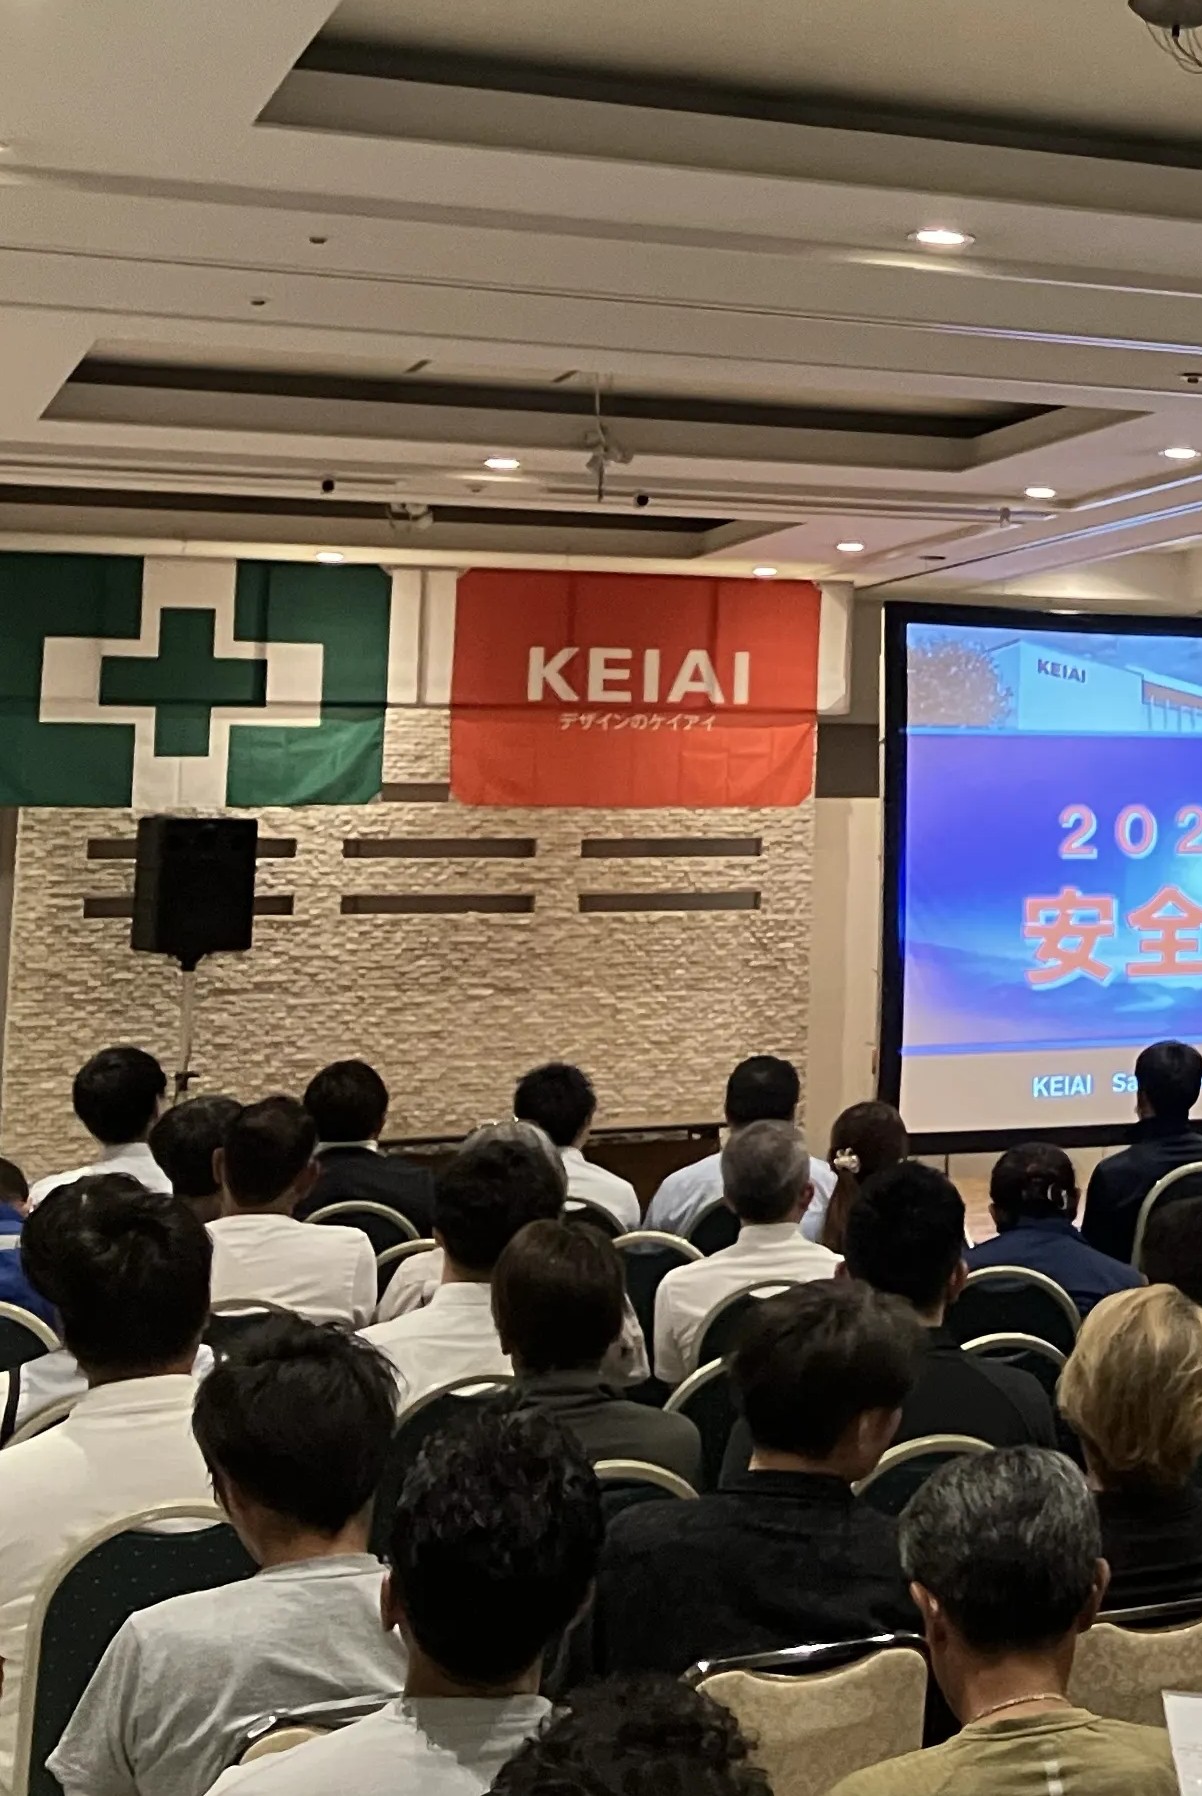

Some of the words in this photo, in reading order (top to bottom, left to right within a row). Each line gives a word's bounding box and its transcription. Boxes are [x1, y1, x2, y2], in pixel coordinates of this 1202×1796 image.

[527, 646, 750, 705] KEIAI
[1036, 658, 1087, 683] KEIAI
[560, 711, 717, 731] デザインのケイアイ
[1032, 1075, 1092, 1098] KEIAI
